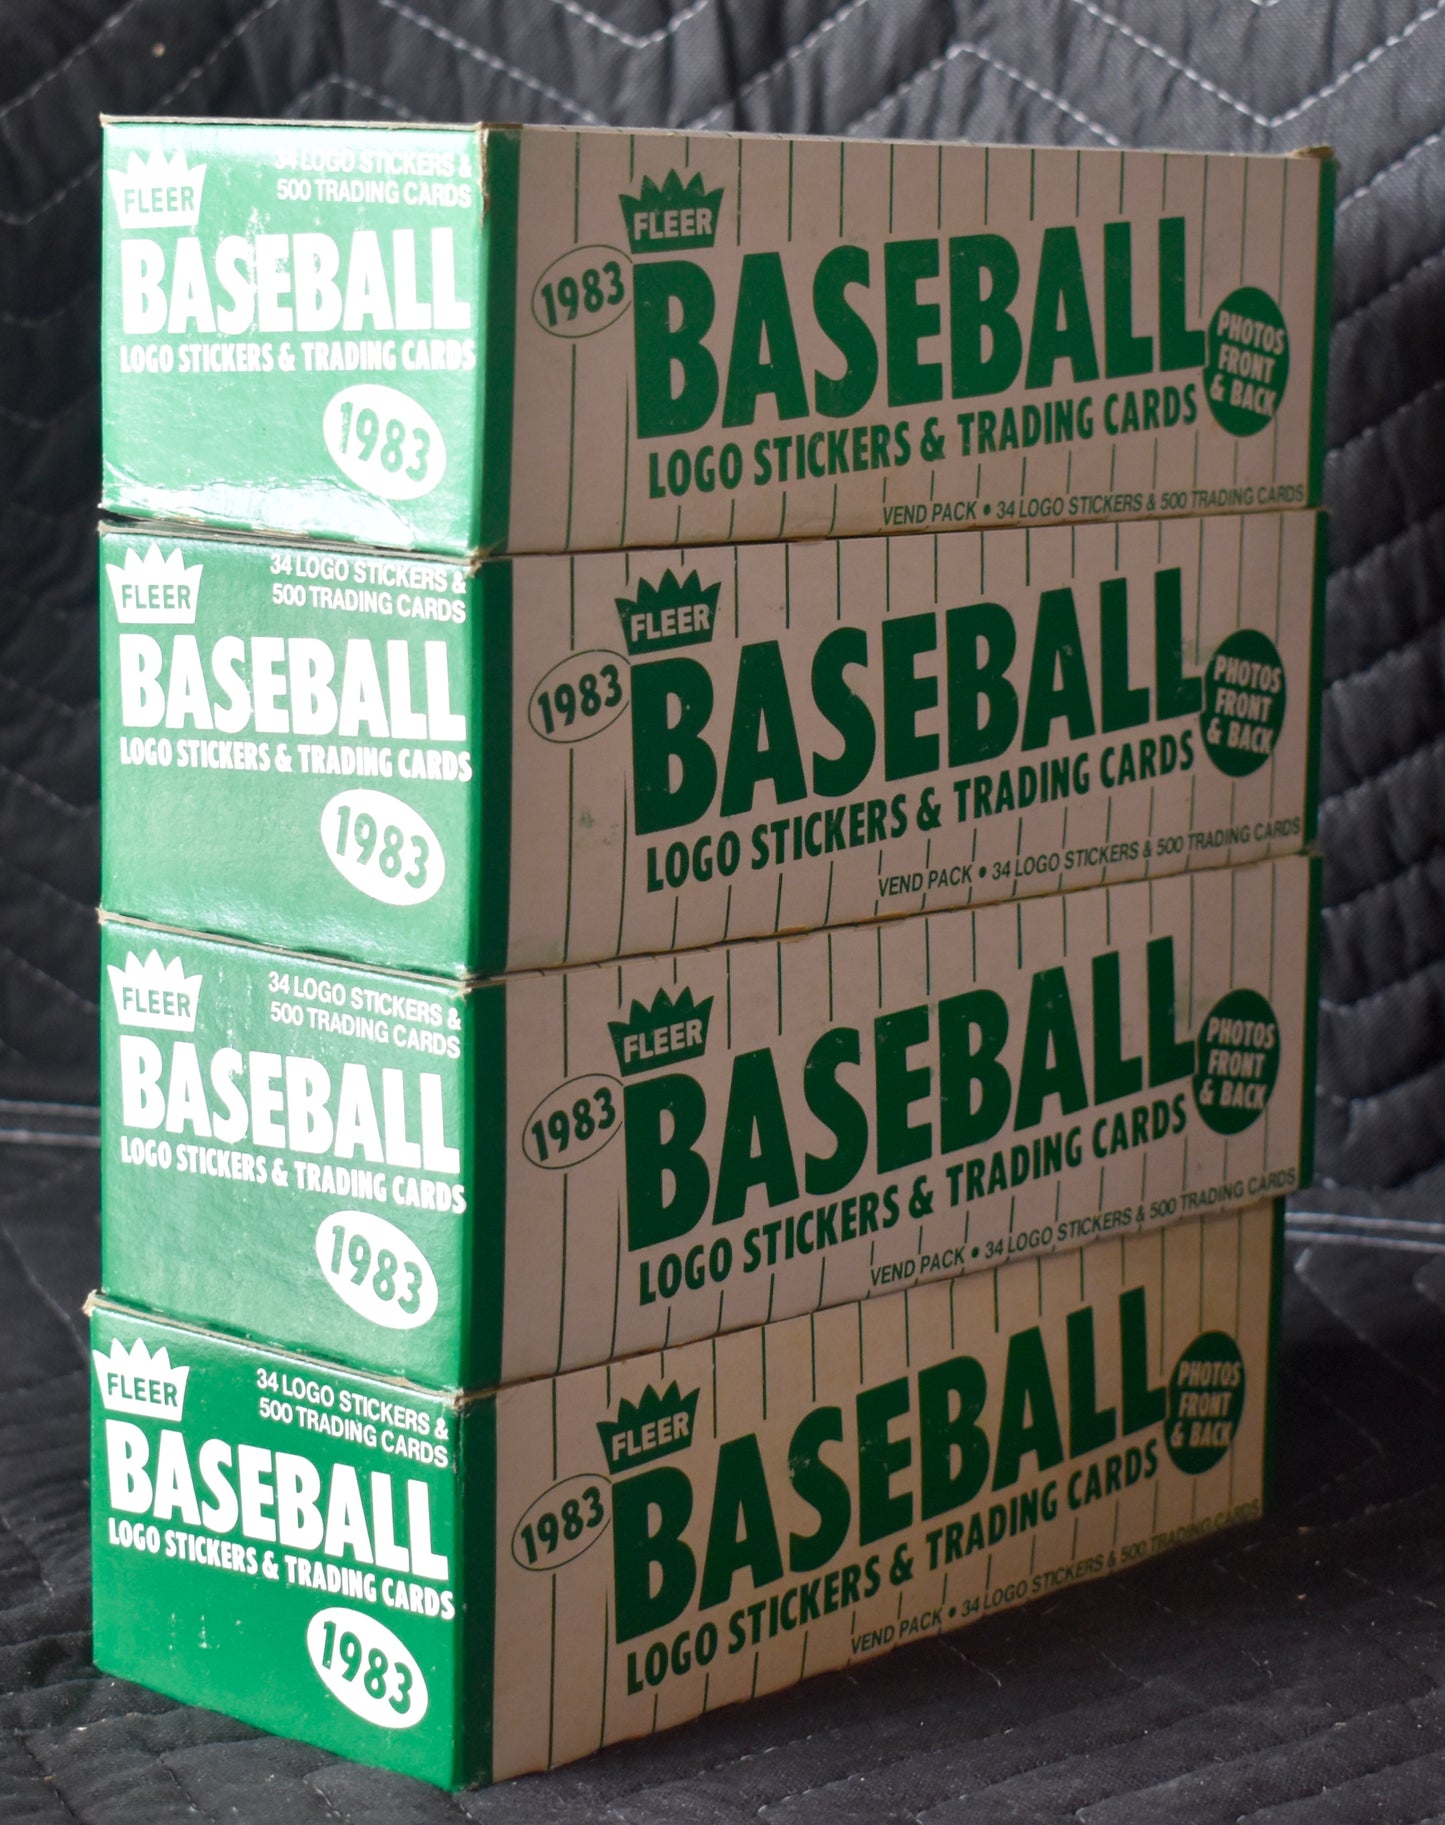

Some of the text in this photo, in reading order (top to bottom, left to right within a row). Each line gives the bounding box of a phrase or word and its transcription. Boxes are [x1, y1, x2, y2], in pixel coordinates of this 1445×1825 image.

[277, 178, 471, 208] 500 TRADING CARDS
[301, 150, 355, 172] LOGO
[359, 151, 455, 177] STICKERS
[458, 154, 472, 178] &
[124, 186, 195, 213] FLEER
[634, 208, 713, 240] FLEER
[120, 227, 471, 335] BASEBALL
[540, 261, 625, 328] 1983
[120, 340, 476, 373] LOGO STICKERS & TRADING CARDS
[632, 215, 1206, 440] BASEBALL
[1217, 310, 1284, 380] PHOTOS FRONT
[1210, 381, 1276, 418] & BACK
[339, 401, 431, 482] 1983
[649, 384, 1197, 499] LOGO STICKERS & TRADING CARDS
[883, 484, 1305, 527] VEND PACK 34 LOGO STICKERS & 500 TRADING CARDS
[122, 584, 191, 610] FLEER
[270, 553, 467, 594] 34 LOGO STICKERS &
[272, 583, 466, 624] 500 TRADING CARDS
[631, 604, 711, 642] FLEER
[119, 633, 467, 741] BASEBALL
[537, 664, 623, 735] 1983
[630, 567, 1203, 836] BASEBALL
[1214, 655, 1281, 724] PHOTOS FRONT
[120, 736, 472, 782] LOGO STICKERS & TRADING CARDS
[1206, 718, 1273, 755] & BACK
[646, 729, 1194, 894] LOGO STICKERS & TRADING CARDS
[336, 805, 429, 889] 1983
[878, 818, 1300, 897] VEND PACK 34 LOGO STICKERS & 500 TRADING CARDS
[122, 986, 191, 1018] FLEER
[268, 971, 462, 1031] 34 LOGO STICKERS &
[270, 1001, 461, 1059] 500 TRADING CARDS
[624, 1019, 704, 1064] FLEER
[1207, 1016, 1275, 1078] PHOTOS FRONT
[120, 1034, 461, 1174] BASEBALL
[531, 1087, 616, 1162] 1983
[623, 935, 1196, 1252] BASEBALL
[1200, 1078, 1267, 1110] & BACK
[121, 1136, 467, 1215] LOGO STICKERS & TRADING CARDS
[639, 1094, 1187, 1306] LOGO STICKERS & TRADING CARDS
[870, 1167, 1296, 1287] VEND PACK 34 LOGO STICKERS & 500 TRADING CARDS
[331, 1225, 423, 1315] 1983
[107, 1372, 178, 1407] FLEER
[256, 1368, 449, 1440] 34 LOGO STICKERS &
[1178, 1361, 1242, 1418] PHOTOS FRONT
[259, 1398, 448, 1468] 500 TRADING CARDS
[612, 1411, 690, 1461] FLEER
[612, 1286, 1166, 1644] BASEBALL
[1170, 1422, 1234, 1448] & BACK
[105, 1419, 449, 1581] BASEBALL
[520, 1486, 604, 1564] 1983
[108, 1517, 455, 1621] LOGO STICKERS & TRADING CARDS
[626, 1439, 1158, 1696] LOGO STICKERS & TRADING CARDS
[851, 1625, 895, 1655] VEND
[898, 1607, 943, 1638] PACK
[961, 1596, 979, 1617] 34
[983, 1580, 1027, 1610] LOGO
[1031, 1555, 1104, 1593] STICKERS
[1107, 1550, 1116, 1568] &
[1121, 1539, 1147, 1564] 500
[322, 1620, 413, 1715] 1983
